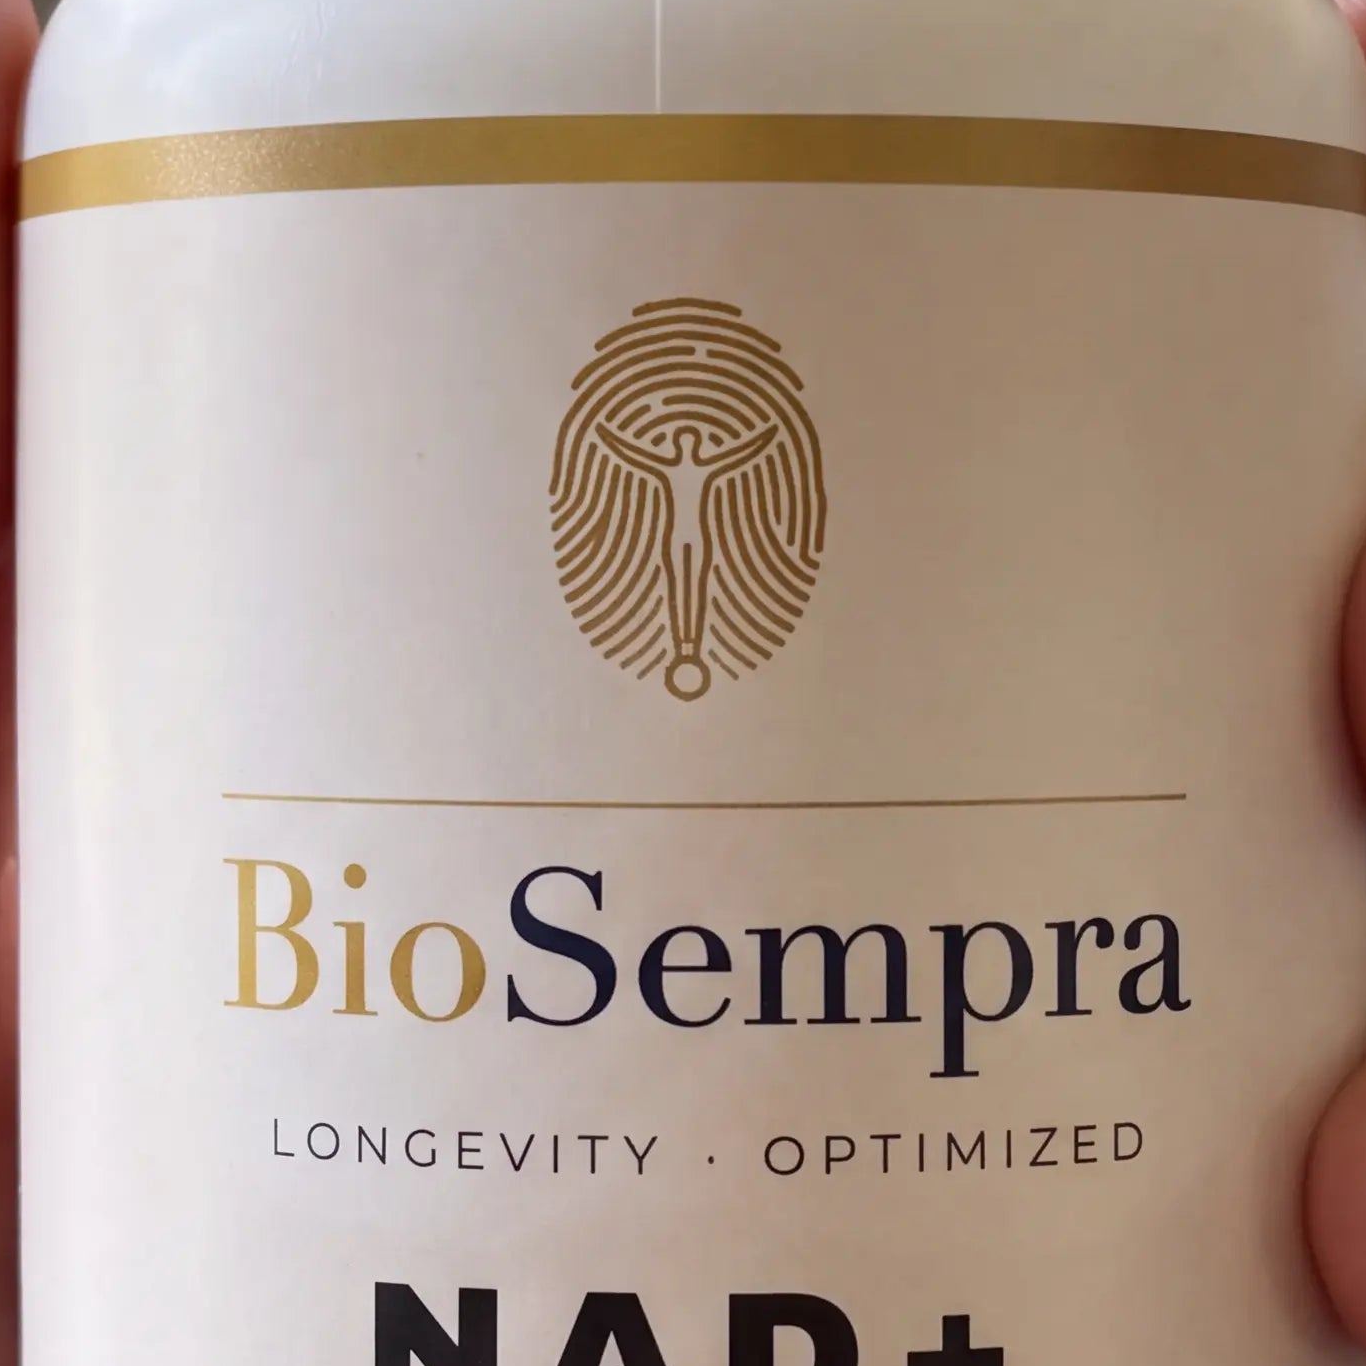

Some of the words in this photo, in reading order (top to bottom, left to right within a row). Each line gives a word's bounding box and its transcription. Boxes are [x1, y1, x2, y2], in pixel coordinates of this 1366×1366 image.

[222, 857, 1192, 1079] BioSempra
[273, 1117, 658, 1176] LONGEVITY
[763, 1121, 1143, 1176] OPTIMIZED
